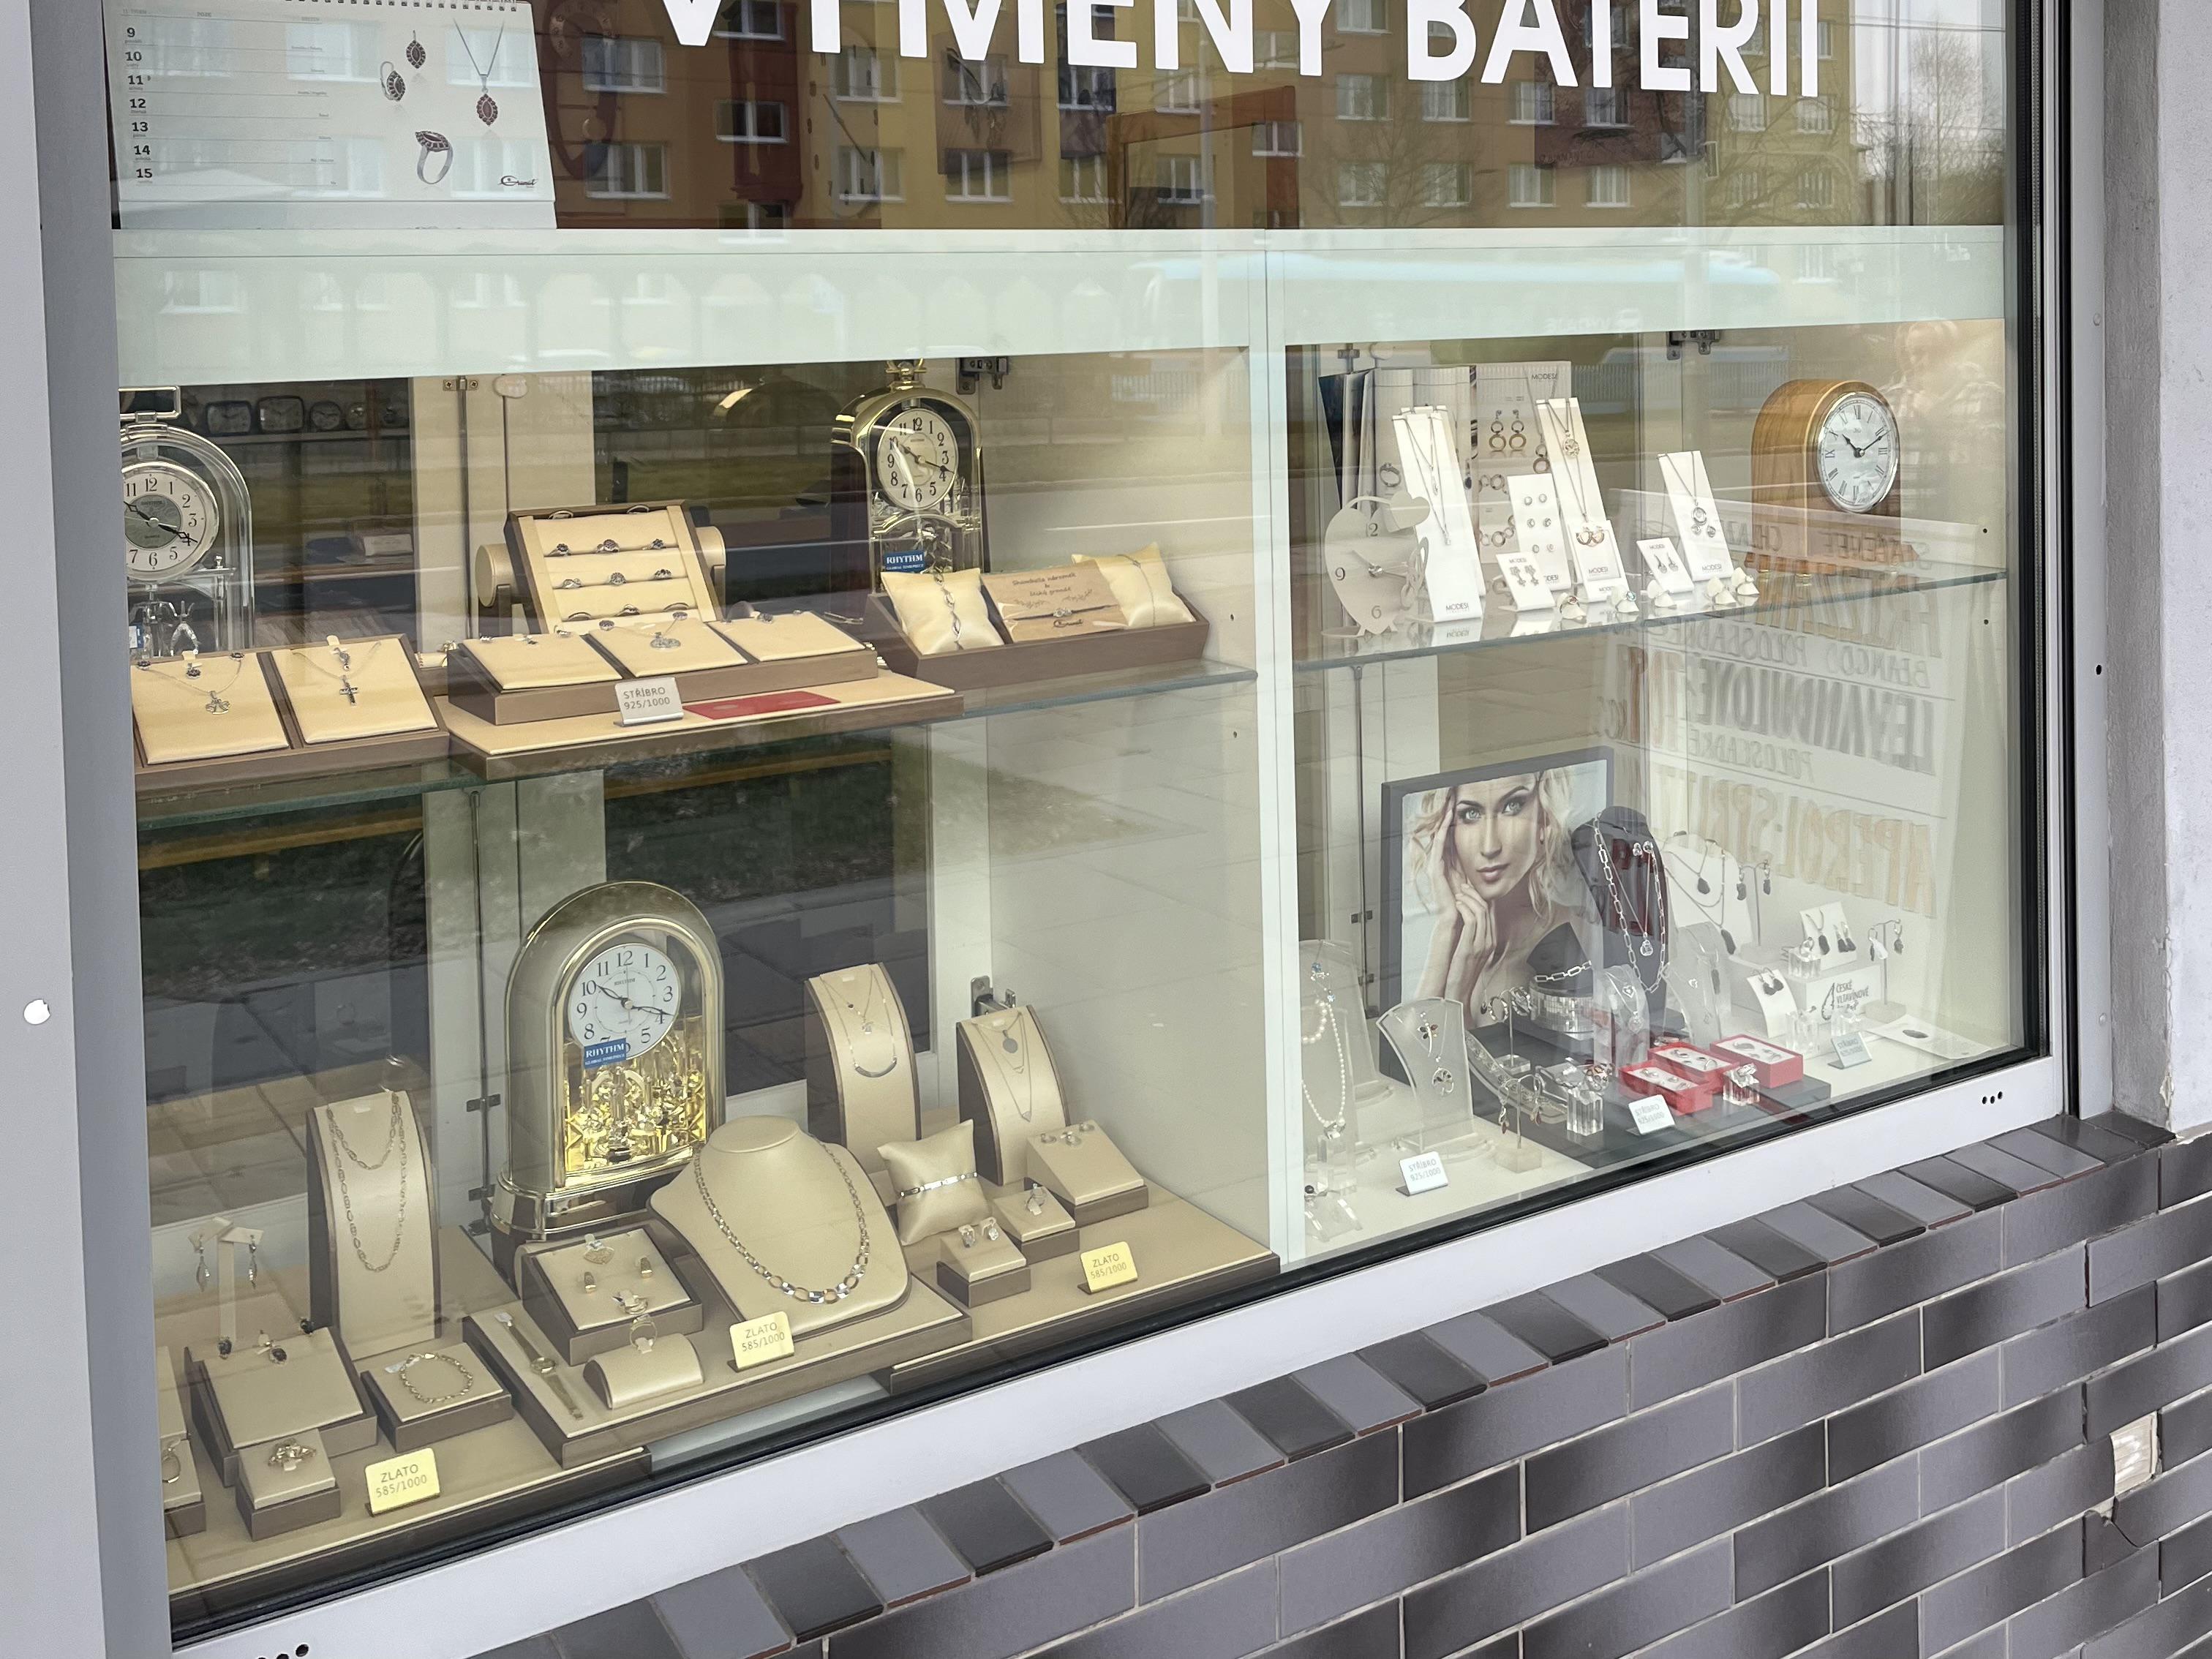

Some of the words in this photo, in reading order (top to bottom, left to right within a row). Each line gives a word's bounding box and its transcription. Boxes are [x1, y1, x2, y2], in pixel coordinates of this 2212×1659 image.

[127, 27, 135, 38] 9
[125, 51, 142, 61] 10
[127, 75, 144, 85] 11
[129, 98, 146, 109] 12
[132, 121, 148, 132] 13
[134, 145, 151, 155] 14
[136, 168, 153, 178] 15
[913, 417, 922, 431] 12
[937, 432, 944, 446] 2
[887, 454, 895, 468] 9
[941, 450, 949, 464] 3
[145, 477, 157, 492] 12
[890, 471, 898, 486] 8
[127, 483, 137, 497] 11
[169, 481, 173, 495] 1
[901, 484, 908, 498] 7
[930, 481, 936, 496] 5
[182, 494, 191, 508] 2
[915, 488, 922, 503] 6
[188, 513, 197, 527] 3
[129, 549, 138, 563] 7
[148, 552, 158, 567] 6
[169, 546, 178, 560] 5
[886, 554, 923, 564] RHYTHM
[1335, 567, 1345, 581] 9
[1371, 605, 1382, 619] 6
[623, 686, 666, 699] STŘÍBRO
[623, 697, 671, 710] 925/1000
[617, 950, 633, 968] 12
[644, 952, 650, 968] 1
[597, 961, 609, 977] 11
[656, 965, 667, 982] 2
[582, 980, 597, 996] 10
[663, 985, 673, 1002] 3
[576, 1002, 587, 1020] 9
[584, 1023, 595, 1039] 8
[641, 1027, 651, 1044] 5
[585, 1043, 625, 1058] RHYTHM
[1092, 1253, 1119, 1268] ZLATO
[1091, 1262, 1127, 1279] 585/1000
[745, 1322, 778, 1339] ZLATO
[742, 1331, 785, 1352] 585/1000
[380, 1464, 418, 1483] ZLATO
[375, 1474, 427, 1498] 585/1000
